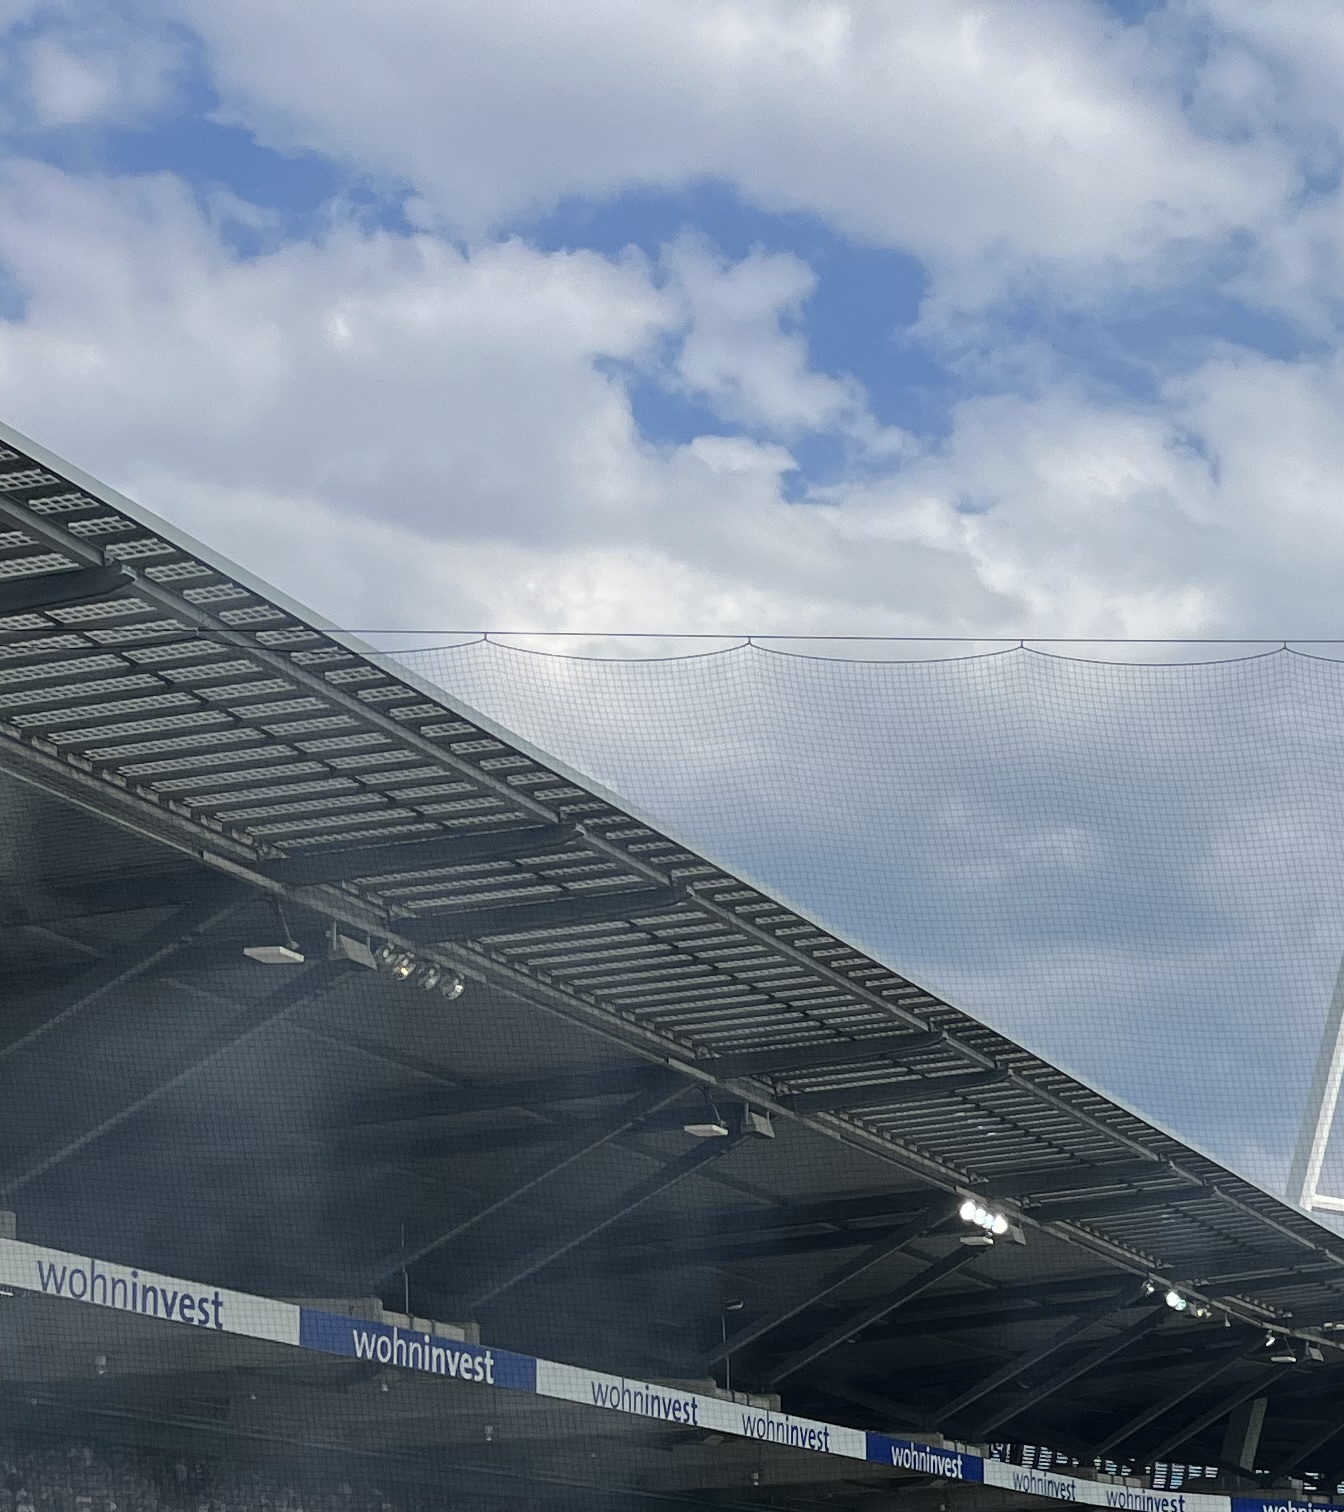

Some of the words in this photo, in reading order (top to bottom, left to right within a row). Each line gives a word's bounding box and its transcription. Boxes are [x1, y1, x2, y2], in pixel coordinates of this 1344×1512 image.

[37, 1258, 223, 1330] wohninvest
[352, 1327, 494, 1385] wohninvest
[591, 1378, 699, 1427] wohninvest
[742, 1410, 830, 1453] wohninvest
[891, 1441, 962, 1480] wohninvest
[1012, 1467, 1076, 1501] wohninvest
